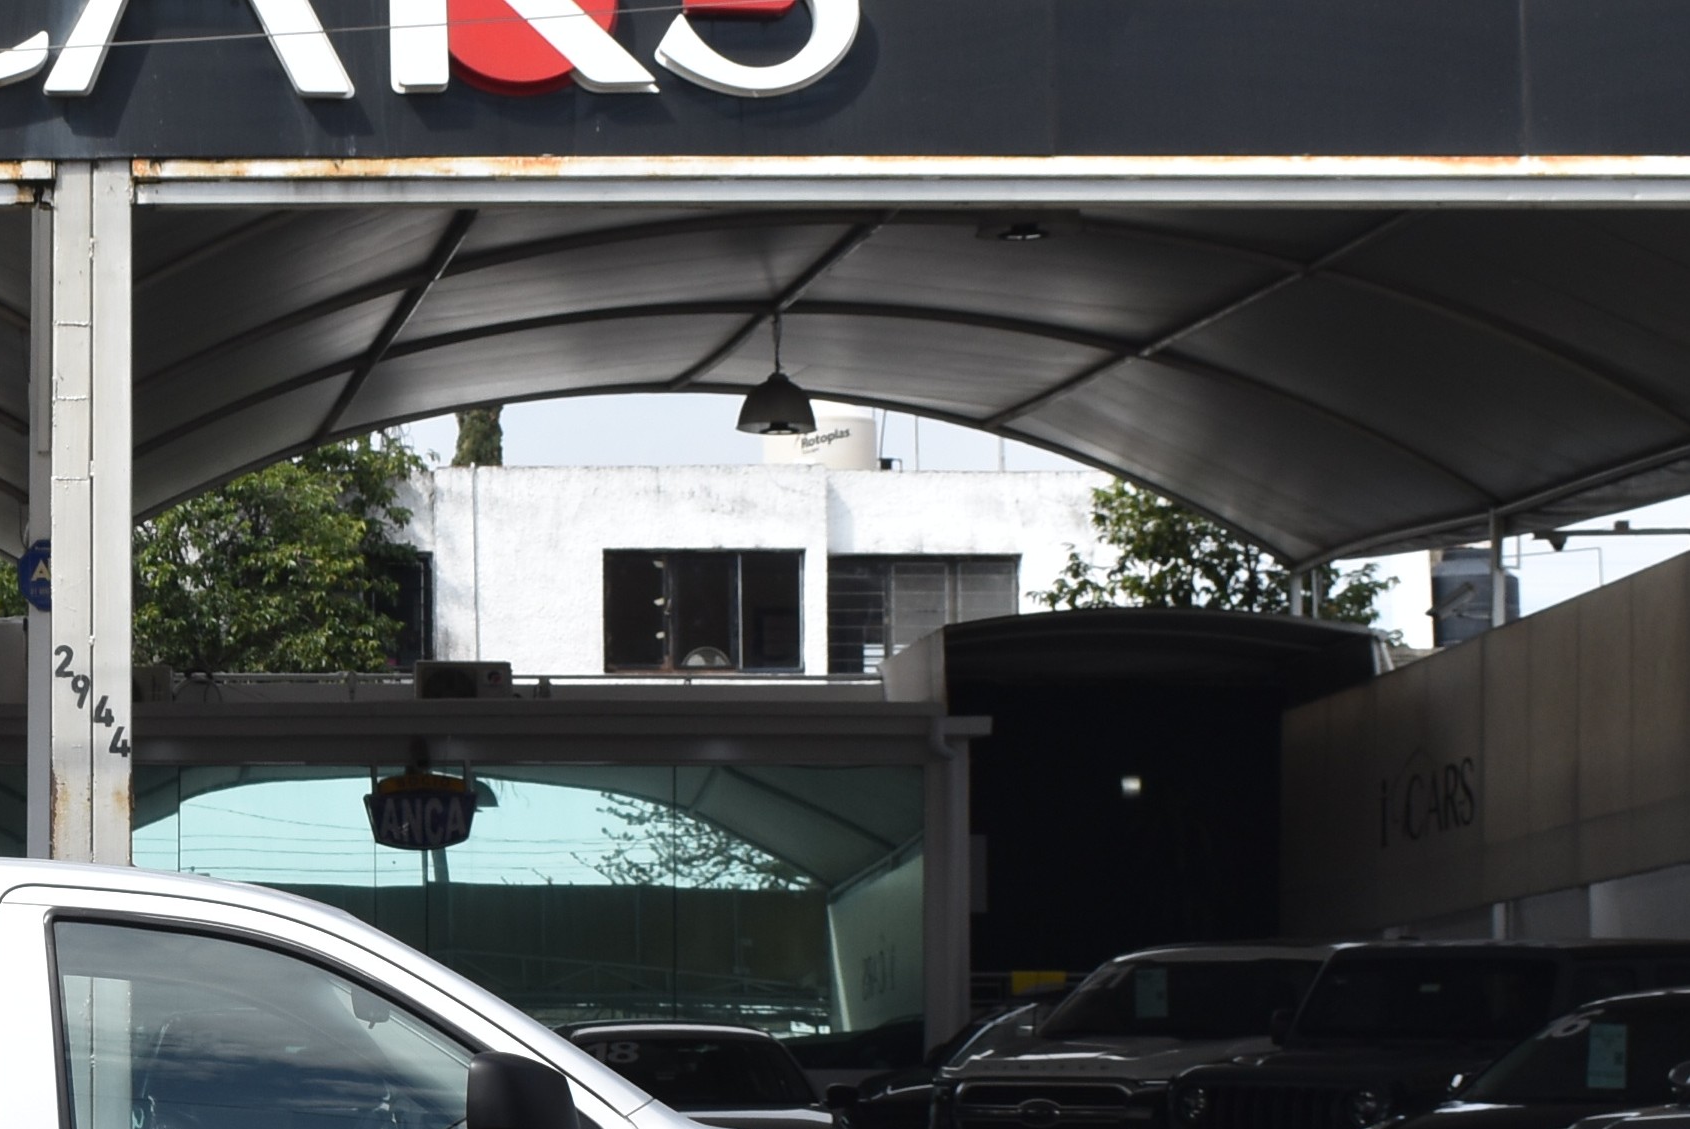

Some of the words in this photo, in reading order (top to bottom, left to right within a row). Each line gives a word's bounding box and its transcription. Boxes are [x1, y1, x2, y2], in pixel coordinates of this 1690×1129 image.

[801, 428, 851, 449] Rotoplas
[1405, 757, 1474, 840] CARS
[380, 797, 467, 845] ANCA
[583, 1041, 640, 1064] 18
